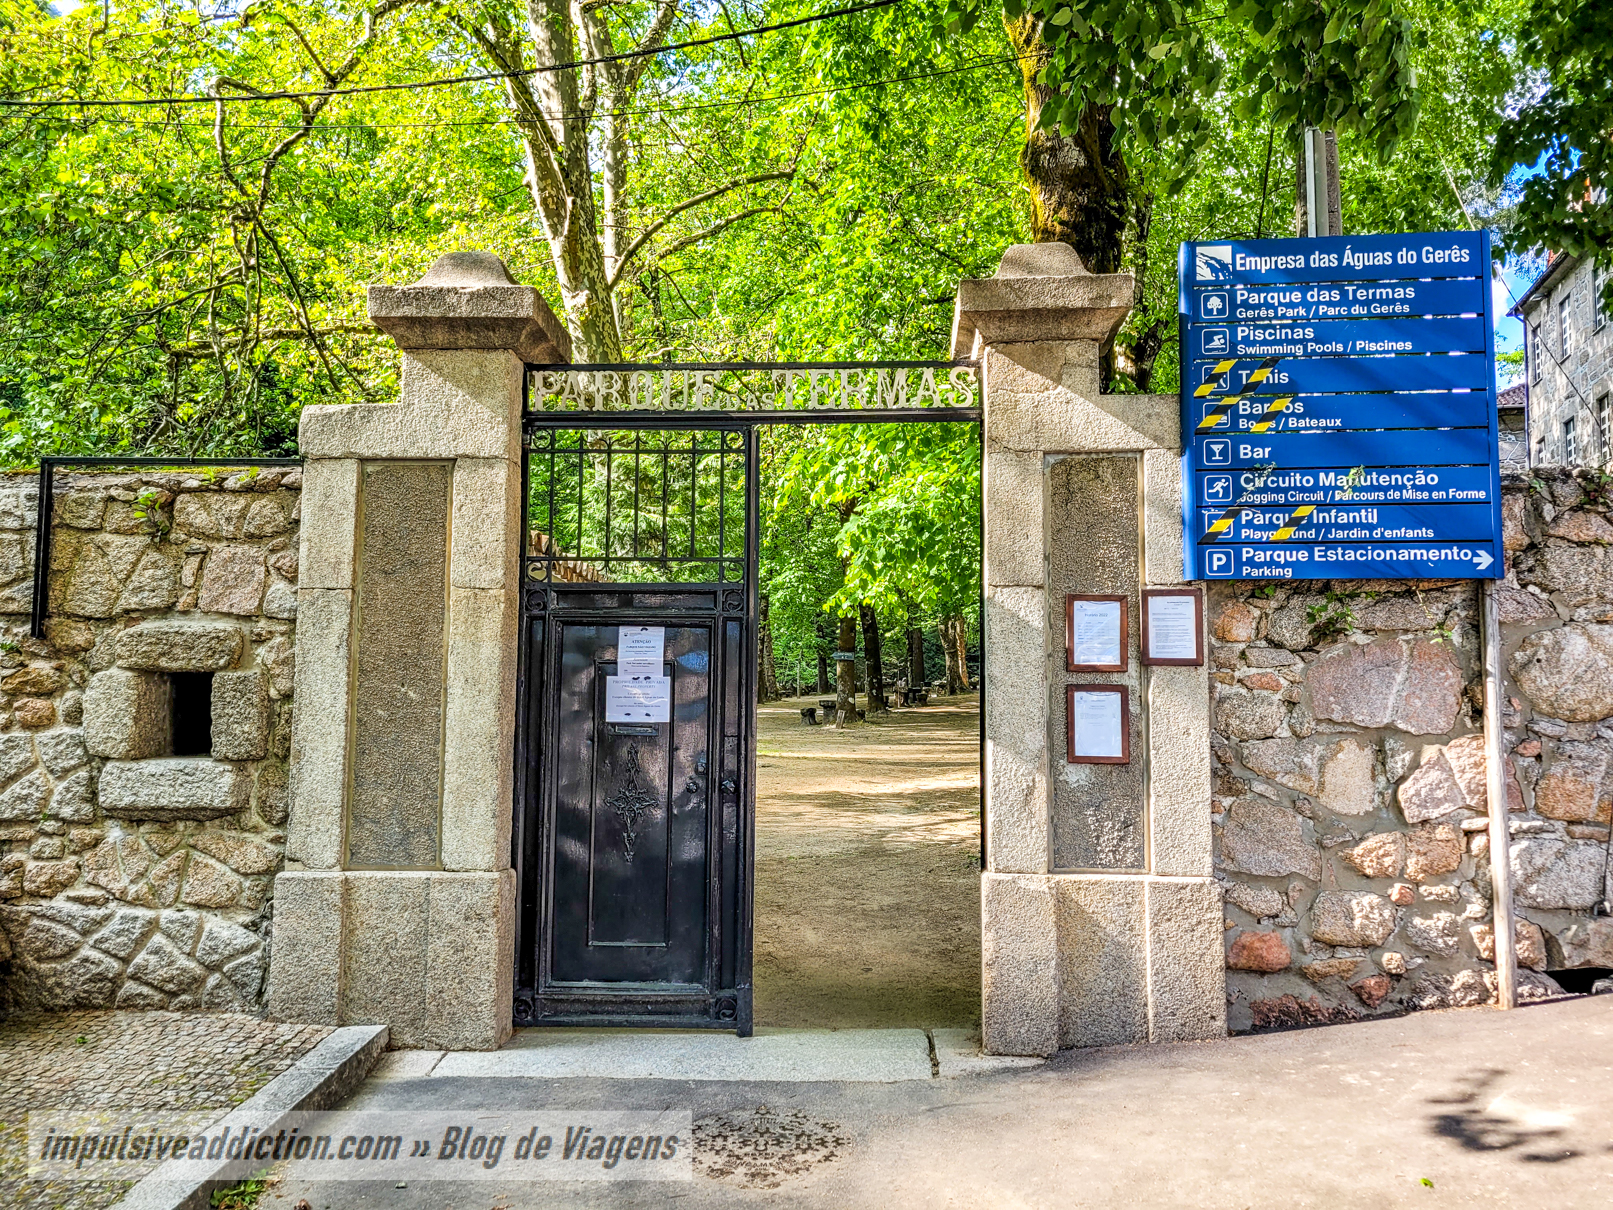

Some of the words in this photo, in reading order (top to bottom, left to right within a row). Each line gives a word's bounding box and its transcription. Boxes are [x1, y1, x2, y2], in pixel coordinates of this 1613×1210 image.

[1236, 253, 1305, 273] Empresa
[1310, 251, 1338, 268] das
[1343, 245, 1393, 270] Águas
[1398, 248, 1416, 265] do
[1422, 245, 1470, 264] Gerês
[1236, 290, 1302, 306] Parque
[1307, 288, 1340, 302] das
[1345, 285, 1415, 300] Termas
[1236, 307, 1274, 319] Gerês
[1277, 306, 1307, 317] Park
[1309, 306, 1315, 318] /
[1319, 305, 1348, 316] Parc
[1351, 304, 1367, 315] du
[1371, 302, 1410, 314] Gerês
[1237, 325, 1315, 341] Piscinas
[1237, 343, 1304, 356] Swimming
[1308, 342, 1344, 352] Pools
[1346, 341, 1352, 353] /
[1356, 339, 1413, 351] Piscines
[1238, 369, 1289, 385] Tnis
[532, 370, 721, 411] PARQUE
[724, 392, 775, 411] DAS
[772, 366, 977, 410] TERMAS
[1238, 400, 1304, 415] Baros
[1239, 418, 1276, 429] Bos
[1279, 417, 1285, 430] /
[1288, 417, 1342, 428] Bateaux
[1239, 445, 1272, 458] Bar
[1240, 471, 1314, 488] Circuito
[1239, 490, 1285, 503] Jogging
[1288, 490, 1324, 501] Circuit
[1326, 490, 1333, 503] /
[1387, 488, 1401, 499] de
[1403, 488, 1428, 499] Mise
[1431, 488, 1446, 499] en
[1449, 488, 1486, 499] Forme
[1313, 508, 1378, 524] Infantil
[1319, 528, 1325, 540] /
[1328, 527, 1369, 538] Jardin
[1373, 526, 1434, 538] d'enfants
[1213, 552, 1227, 570] P
[1242, 548, 1308, 565] Parque
[1314, 546, 1472, 562] Estacionamento
[1242, 566, 1292, 578] Parking
